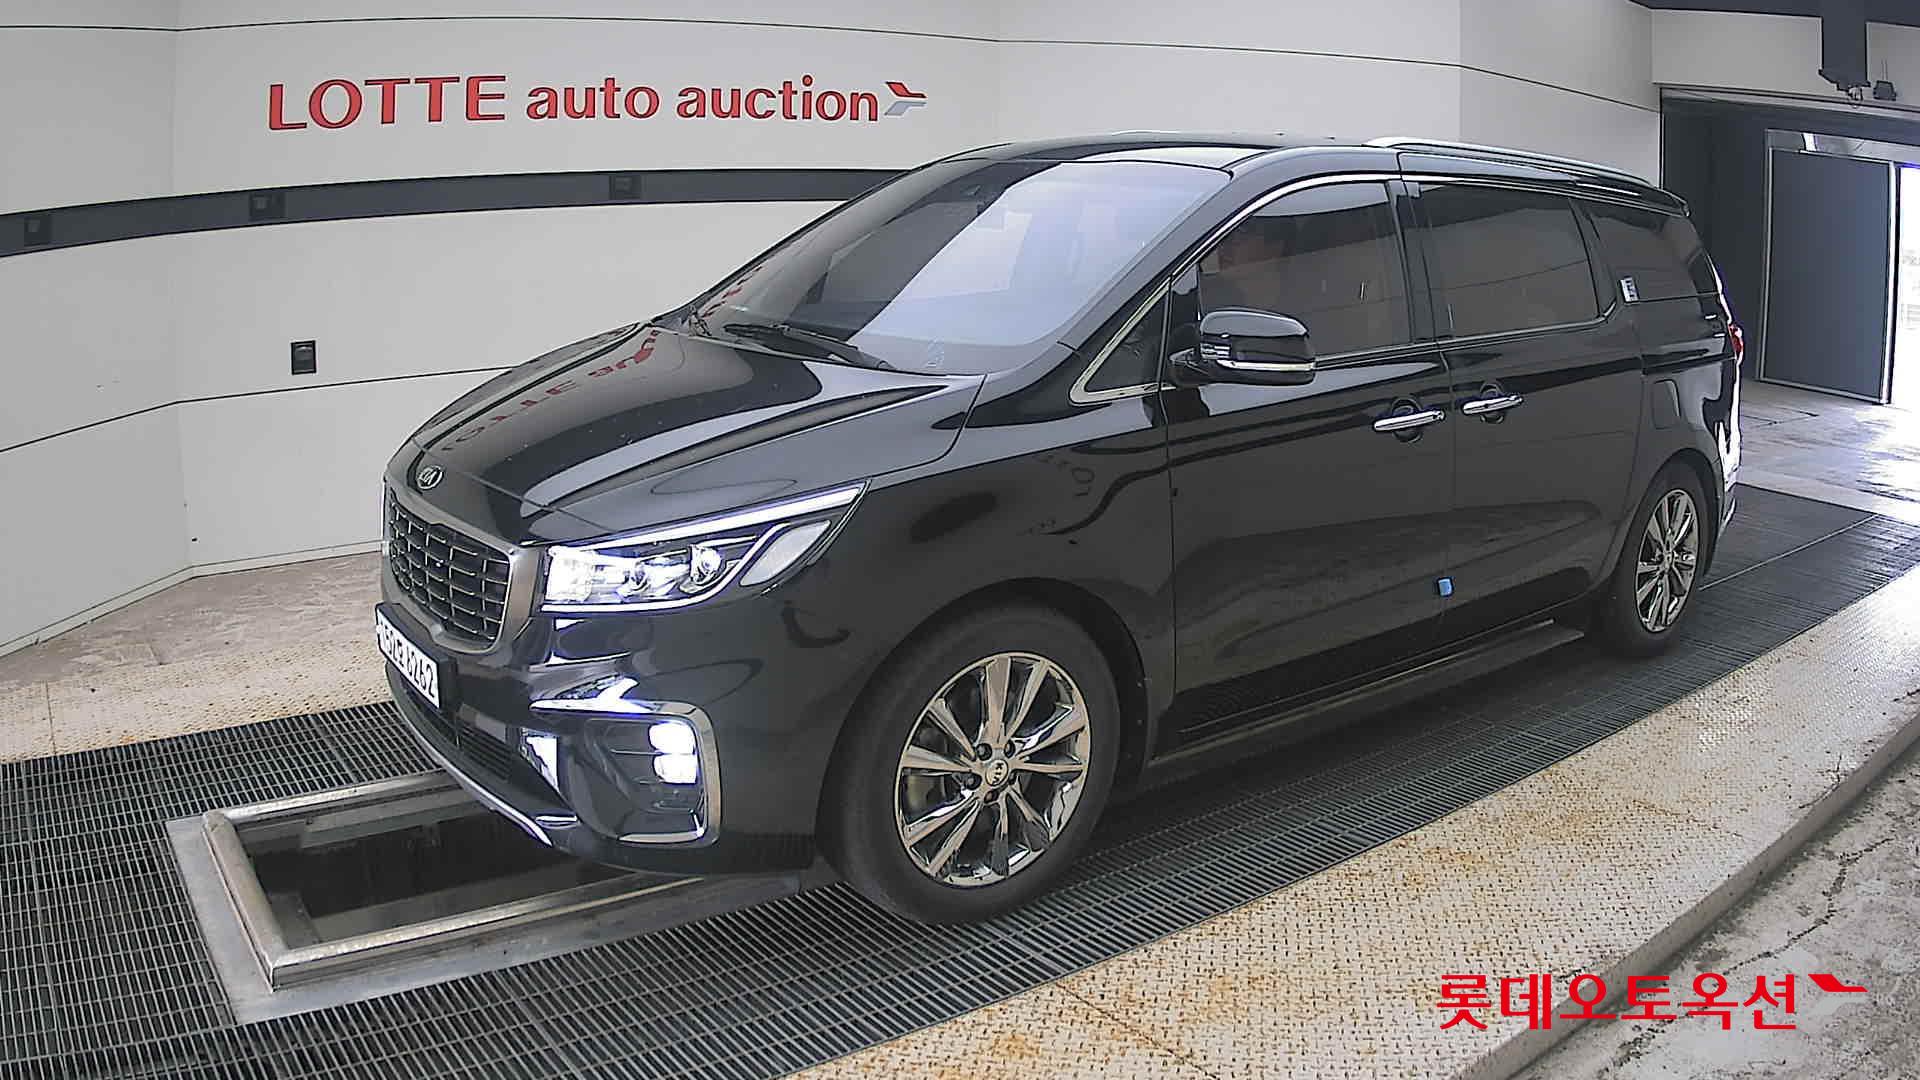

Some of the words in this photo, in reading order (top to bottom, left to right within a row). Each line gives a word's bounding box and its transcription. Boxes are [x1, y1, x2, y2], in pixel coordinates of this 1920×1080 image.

[269, 75, 504, 130] LOTTE
[527, 78, 660, 119] auto
[677, 76, 878, 121] auction
